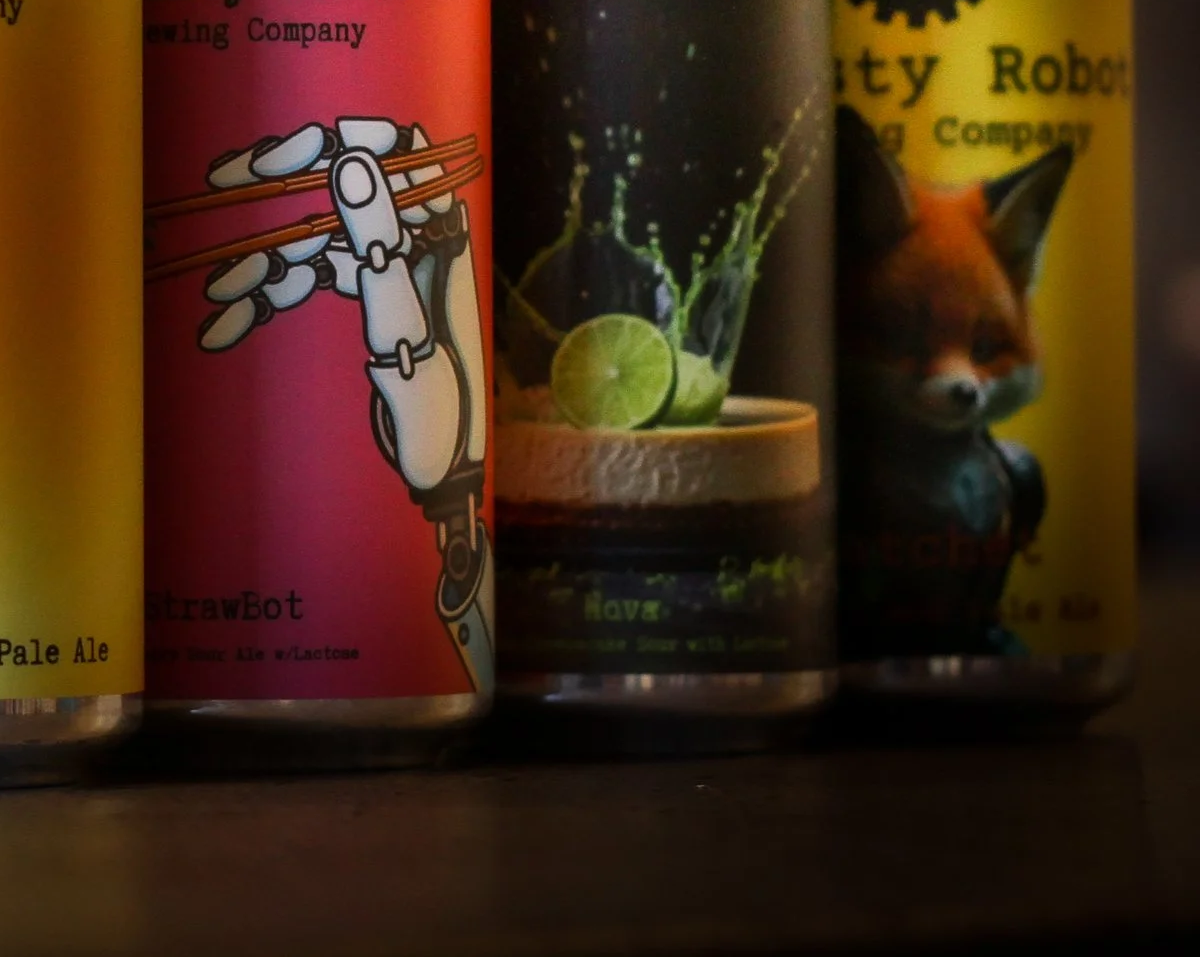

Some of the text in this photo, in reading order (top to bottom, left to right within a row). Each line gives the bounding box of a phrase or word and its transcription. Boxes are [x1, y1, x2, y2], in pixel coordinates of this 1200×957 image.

[248, 18, 367, 49] Company
[987, 40, 1129, 97] Robot
[73, 637, 109, 663] Ale
